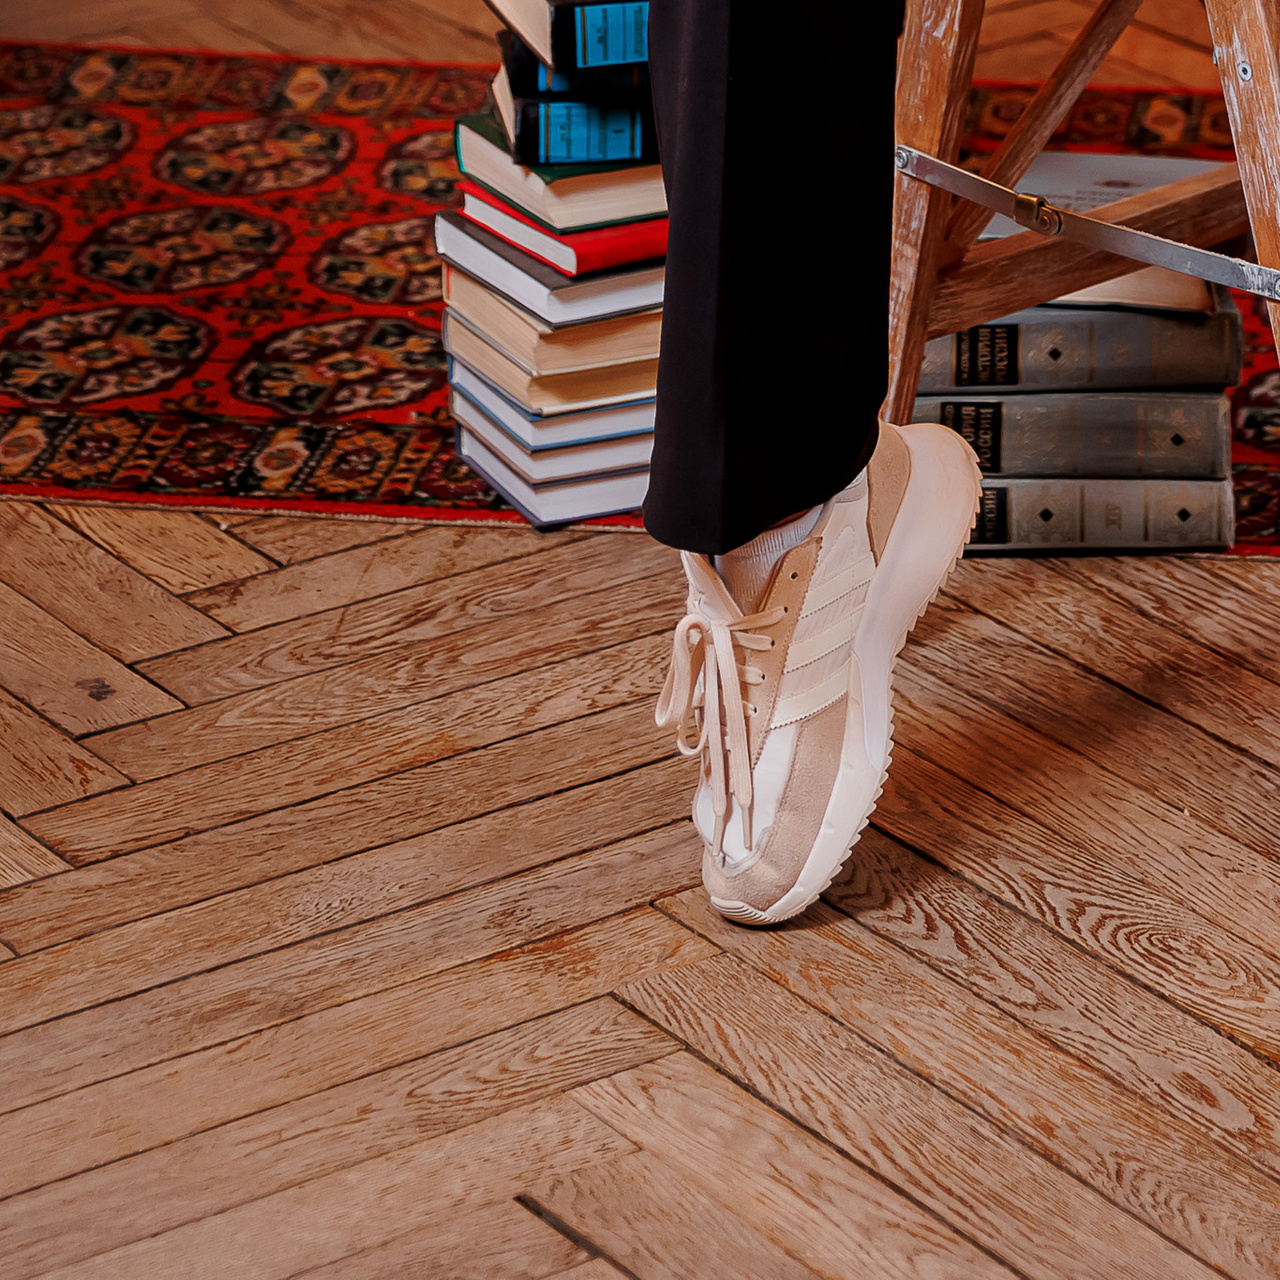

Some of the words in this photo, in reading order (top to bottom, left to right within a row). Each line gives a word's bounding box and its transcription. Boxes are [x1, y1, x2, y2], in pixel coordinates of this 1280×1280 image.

[977, 328, 991, 383] ИСТОРИЯ
[994, 328, 1008, 383] РОССИИ
[961, 406, 976, 443] ОРИЯ
[977, 407, 994, 468] РОССИИ
[983, 490, 998, 542] РОССИИ
